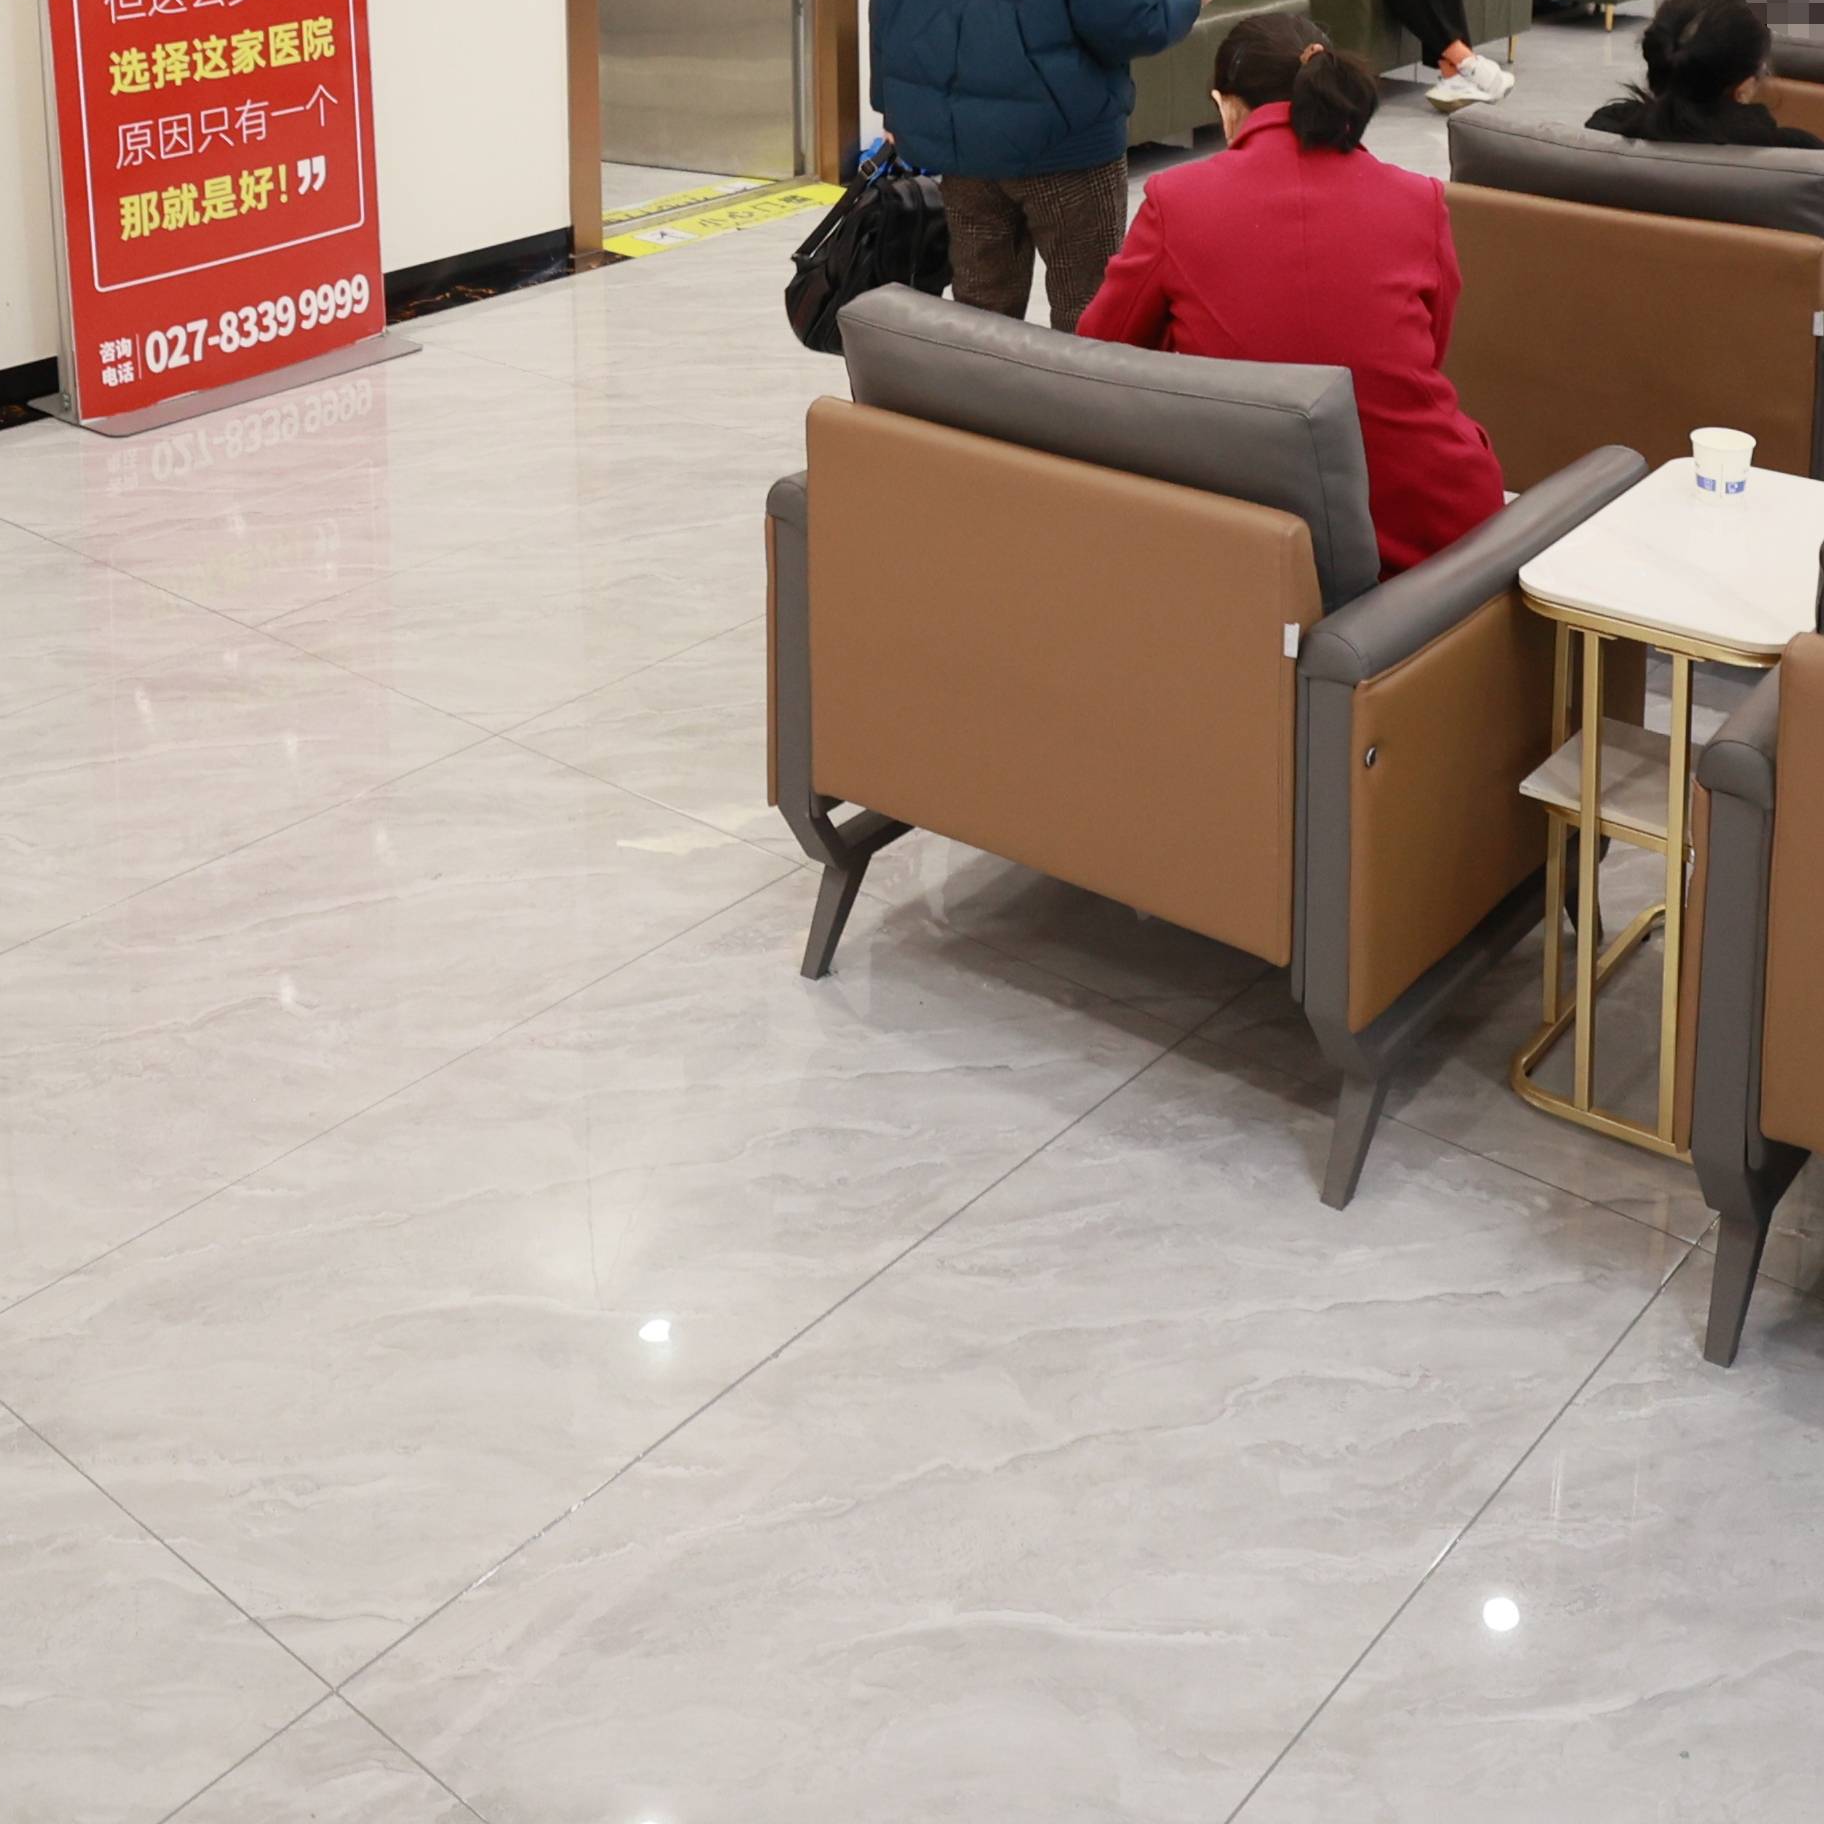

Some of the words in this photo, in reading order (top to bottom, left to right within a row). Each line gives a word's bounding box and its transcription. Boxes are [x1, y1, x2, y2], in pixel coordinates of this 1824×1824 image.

[109, 16, 336, 96] 选择这家医院
[116, 83, 339, 170] 原因只有一个
[99, 336, 133, 362] 咨询
[145, 295, 296, 374] 027-8339
[299, 273, 371, 325] 9999
[101, 360, 135, 388] 电话
